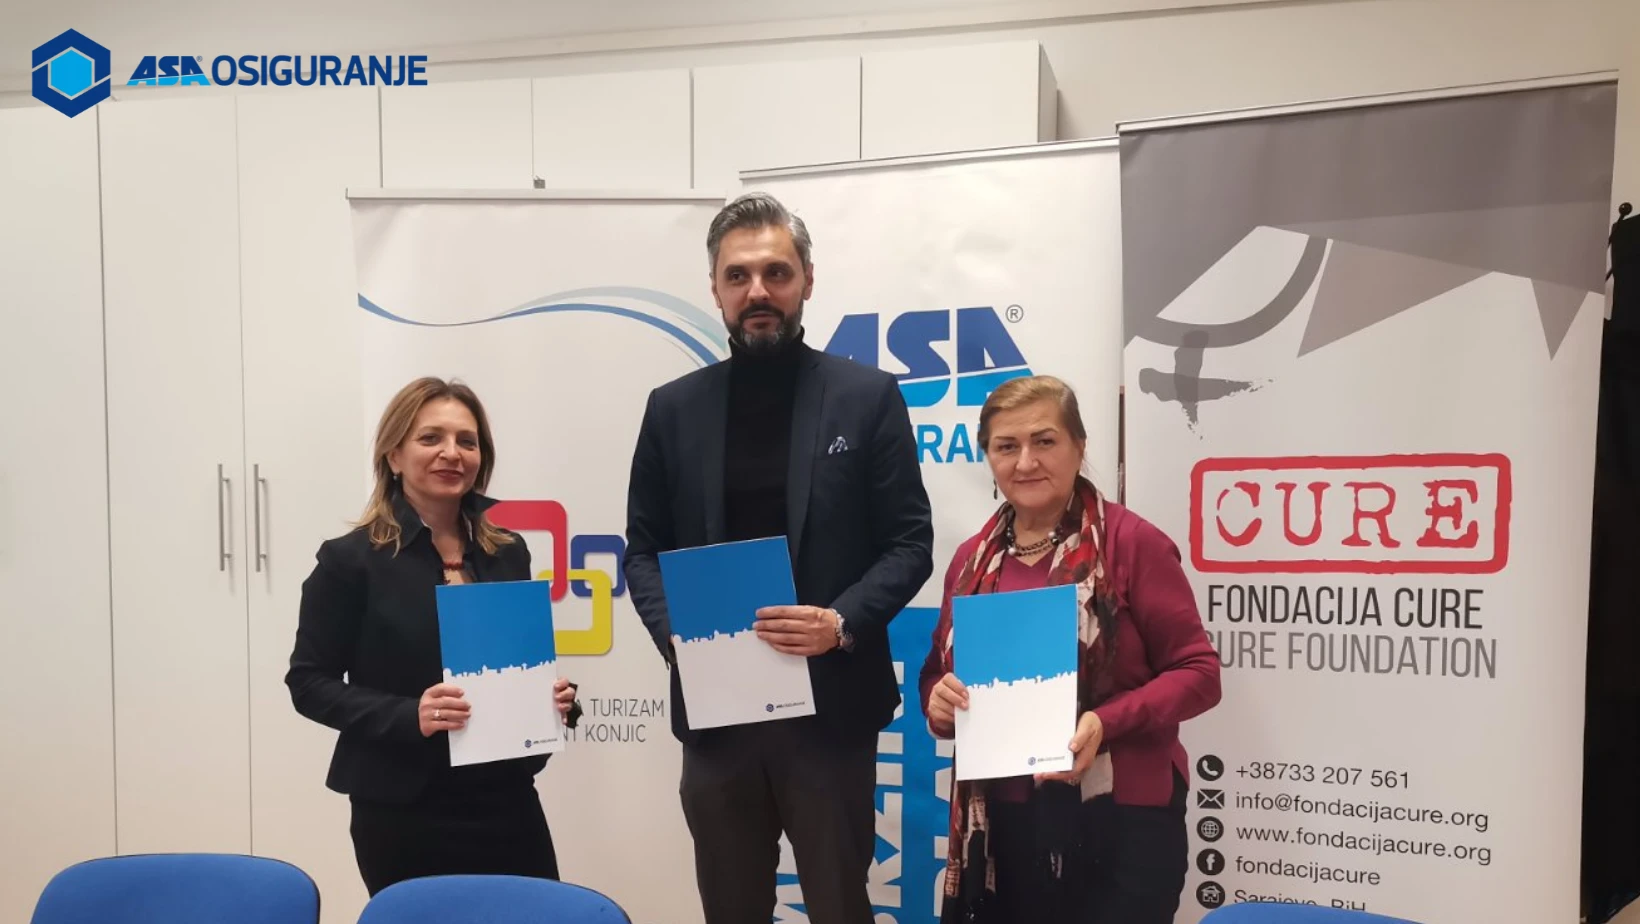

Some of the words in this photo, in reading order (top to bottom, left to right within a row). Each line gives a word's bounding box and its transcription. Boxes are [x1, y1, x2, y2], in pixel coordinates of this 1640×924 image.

[1215, 479, 1480, 549] CURE
[1207, 584, 1383, 627] FONDACIJA
[1393, 587, 1485, 630] CURE
[1205, 629, 1277, 669] URE
[1287, 631, 1498, 679] FOUNDATION
[590, 698, 665, 718] TURIZAM
[585, 723, 647, 743] KONJIC
[1235, 761, 1316, 783] +38733
[1321, 766, 1363, 786] 207
[1370, 769, 1410, 789] 561
[1235, 791, 1489, 833] info@fondacijacure.org
[1235, 825, 1492, 866] www.fondacijacure.org
[1235, 855, 1381, 885] fondacijacure
